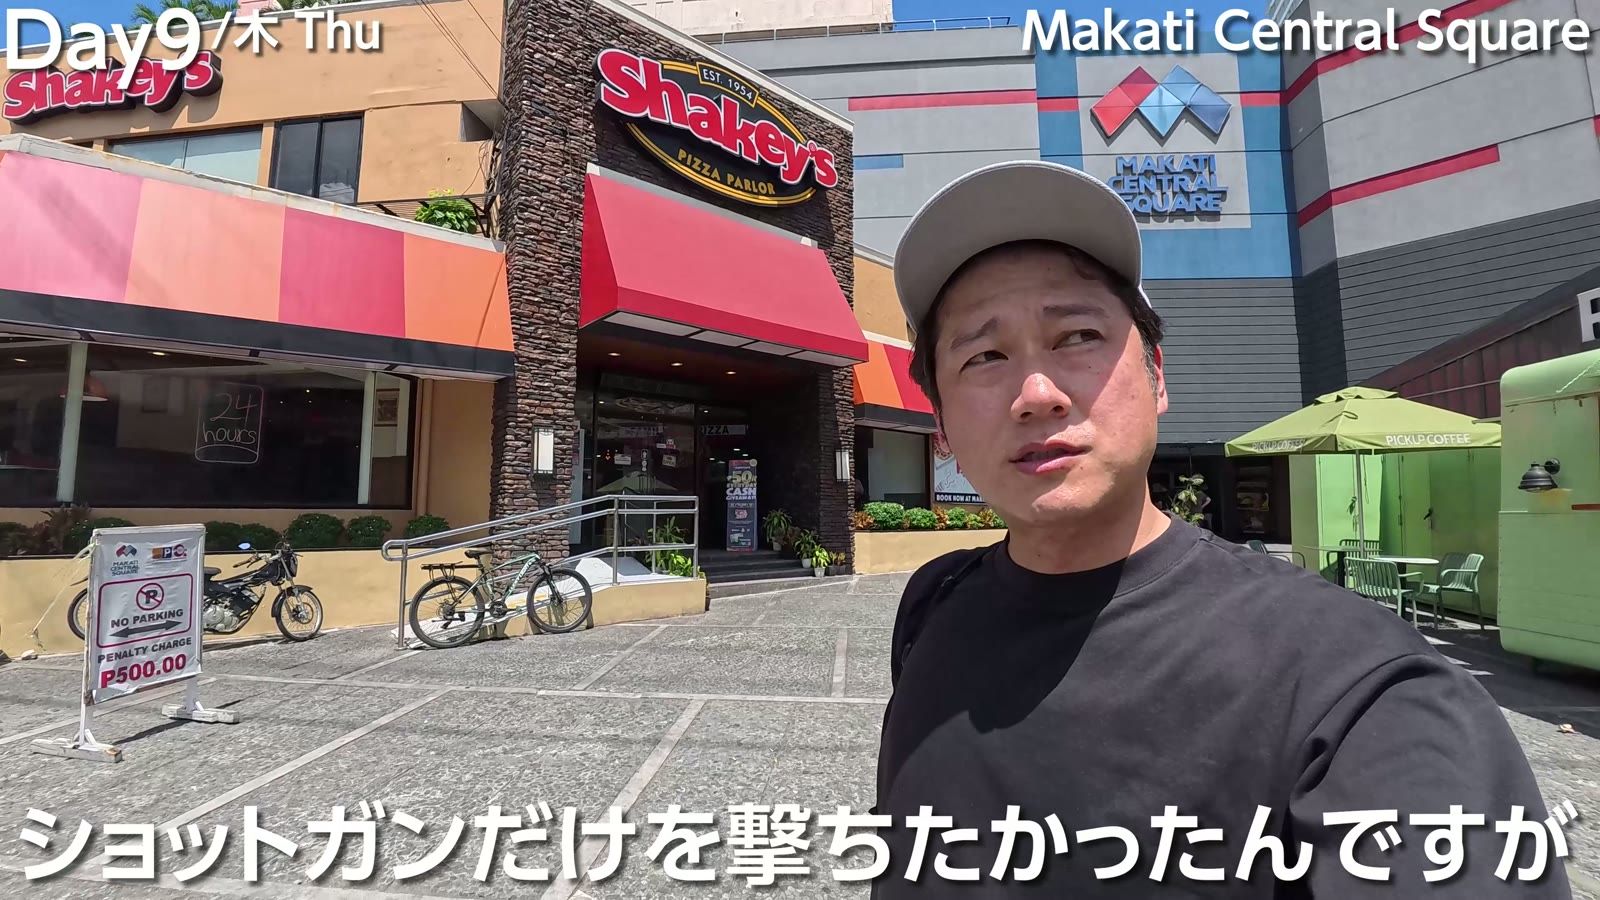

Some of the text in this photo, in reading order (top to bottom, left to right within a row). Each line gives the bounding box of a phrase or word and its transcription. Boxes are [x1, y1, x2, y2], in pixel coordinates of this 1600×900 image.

[3, 50, 214, 119] Shakeys
[702, 68, 754, 100] EST. 1954
[597, 48, 838, 187] Shakey's
[677, 148, 776, 195] PIZZA PARLOR
[1116, 154, 1217, 175] MAKATI
[1107, 174, 1228, 193] CENTRAL
[210, 393, 257, 426] 24
[203, 422, 256, 444] hours
[1385, 433, 1471, 446] PICKUP COFFEE
[726, 487, 757, 496] CASH
[111, 608, 184, 629] NO PARKING
[97, 637, 192, 664] PENALTY CHARGE
